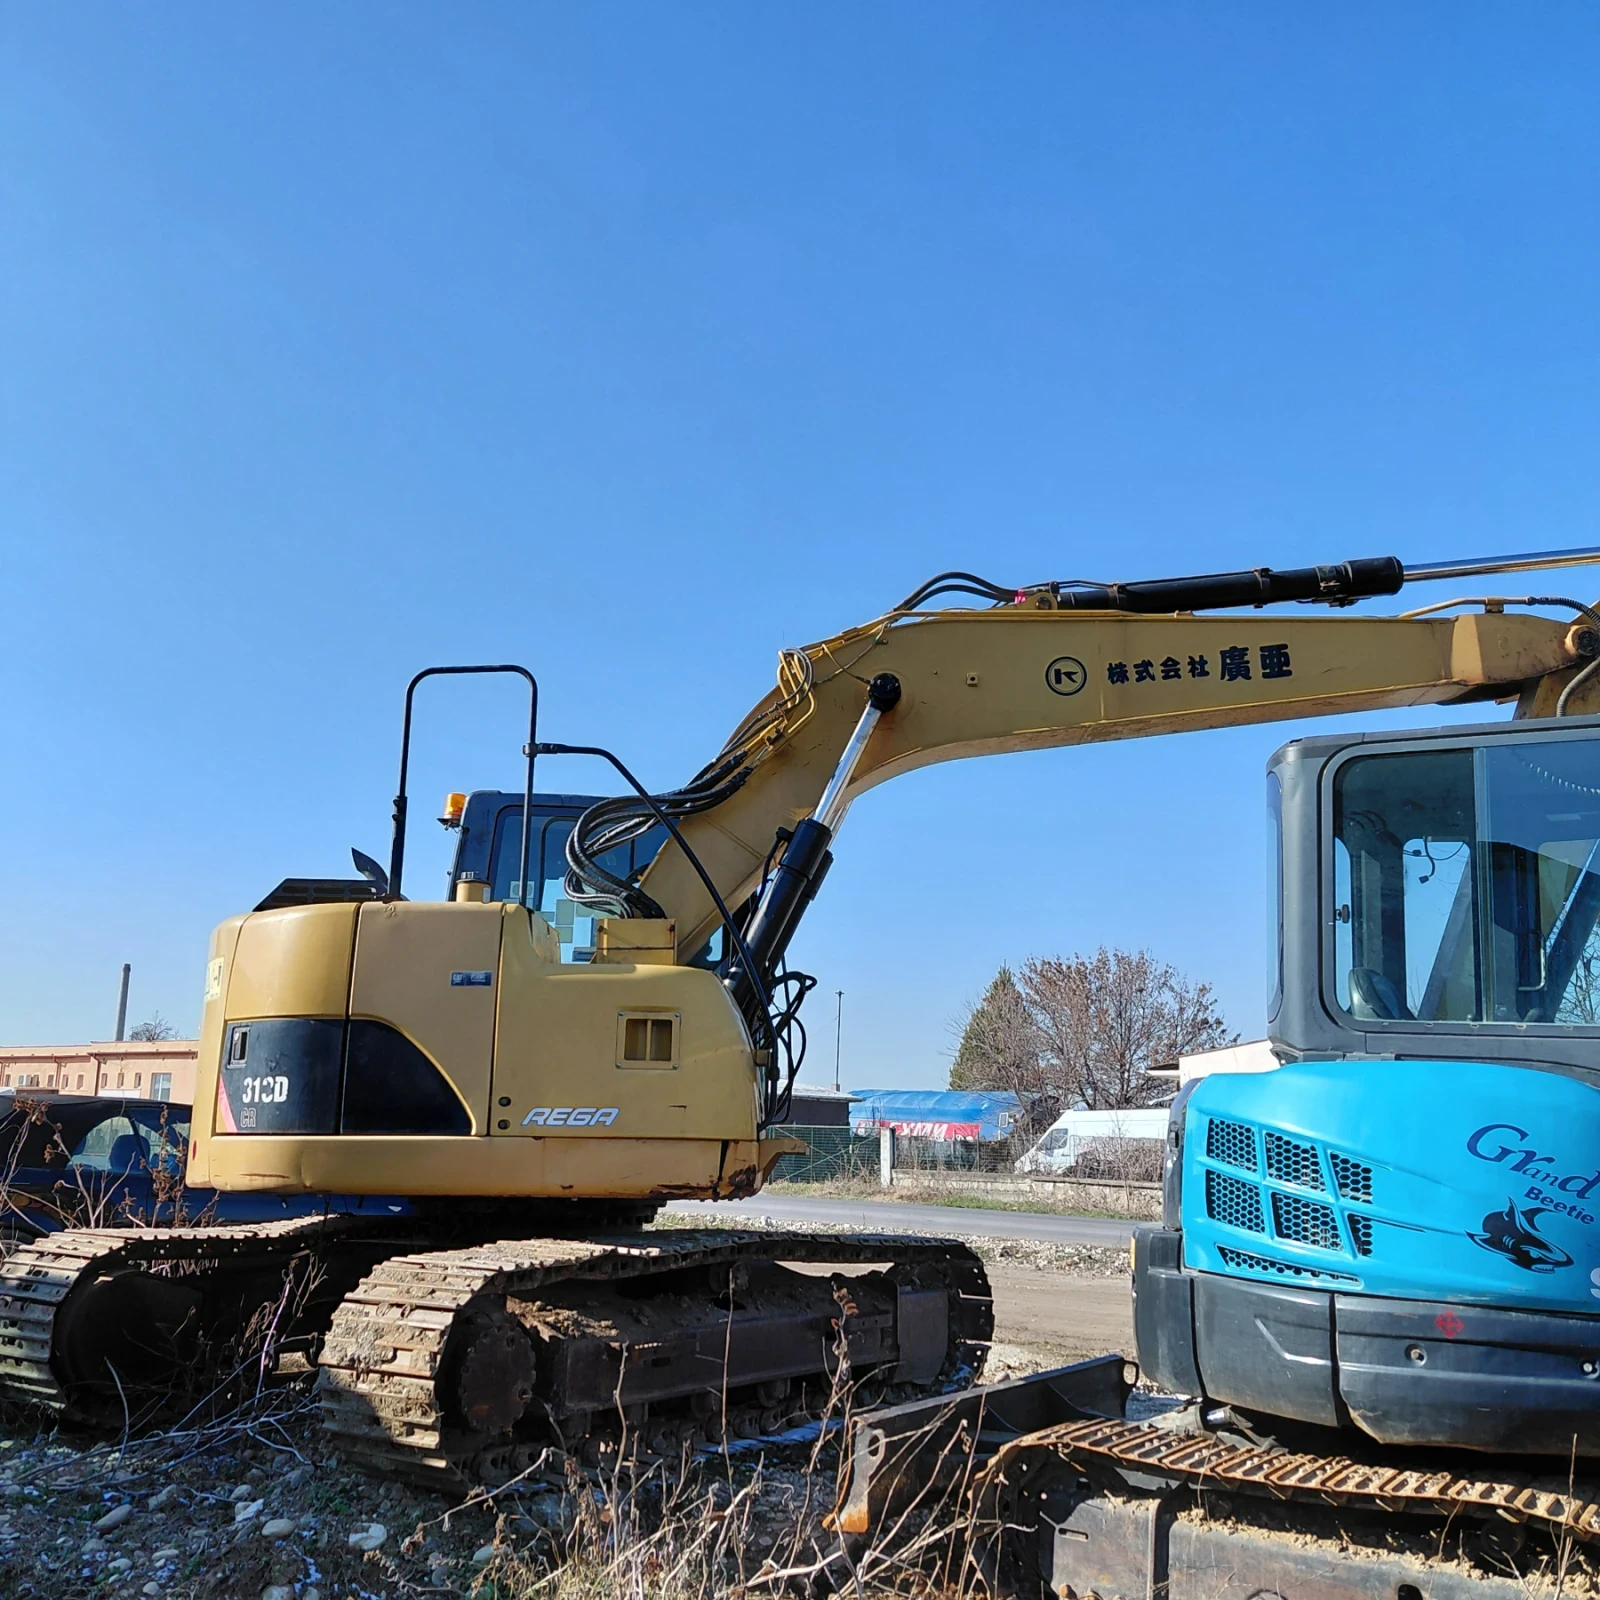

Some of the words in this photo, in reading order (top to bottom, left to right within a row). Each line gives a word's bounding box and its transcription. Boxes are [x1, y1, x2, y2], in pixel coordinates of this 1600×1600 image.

[240, 1106, 257, 1128] CR
[521, 1107, 620, 1126] REGA
[1466, 1123, 1600, 1200] Grand
